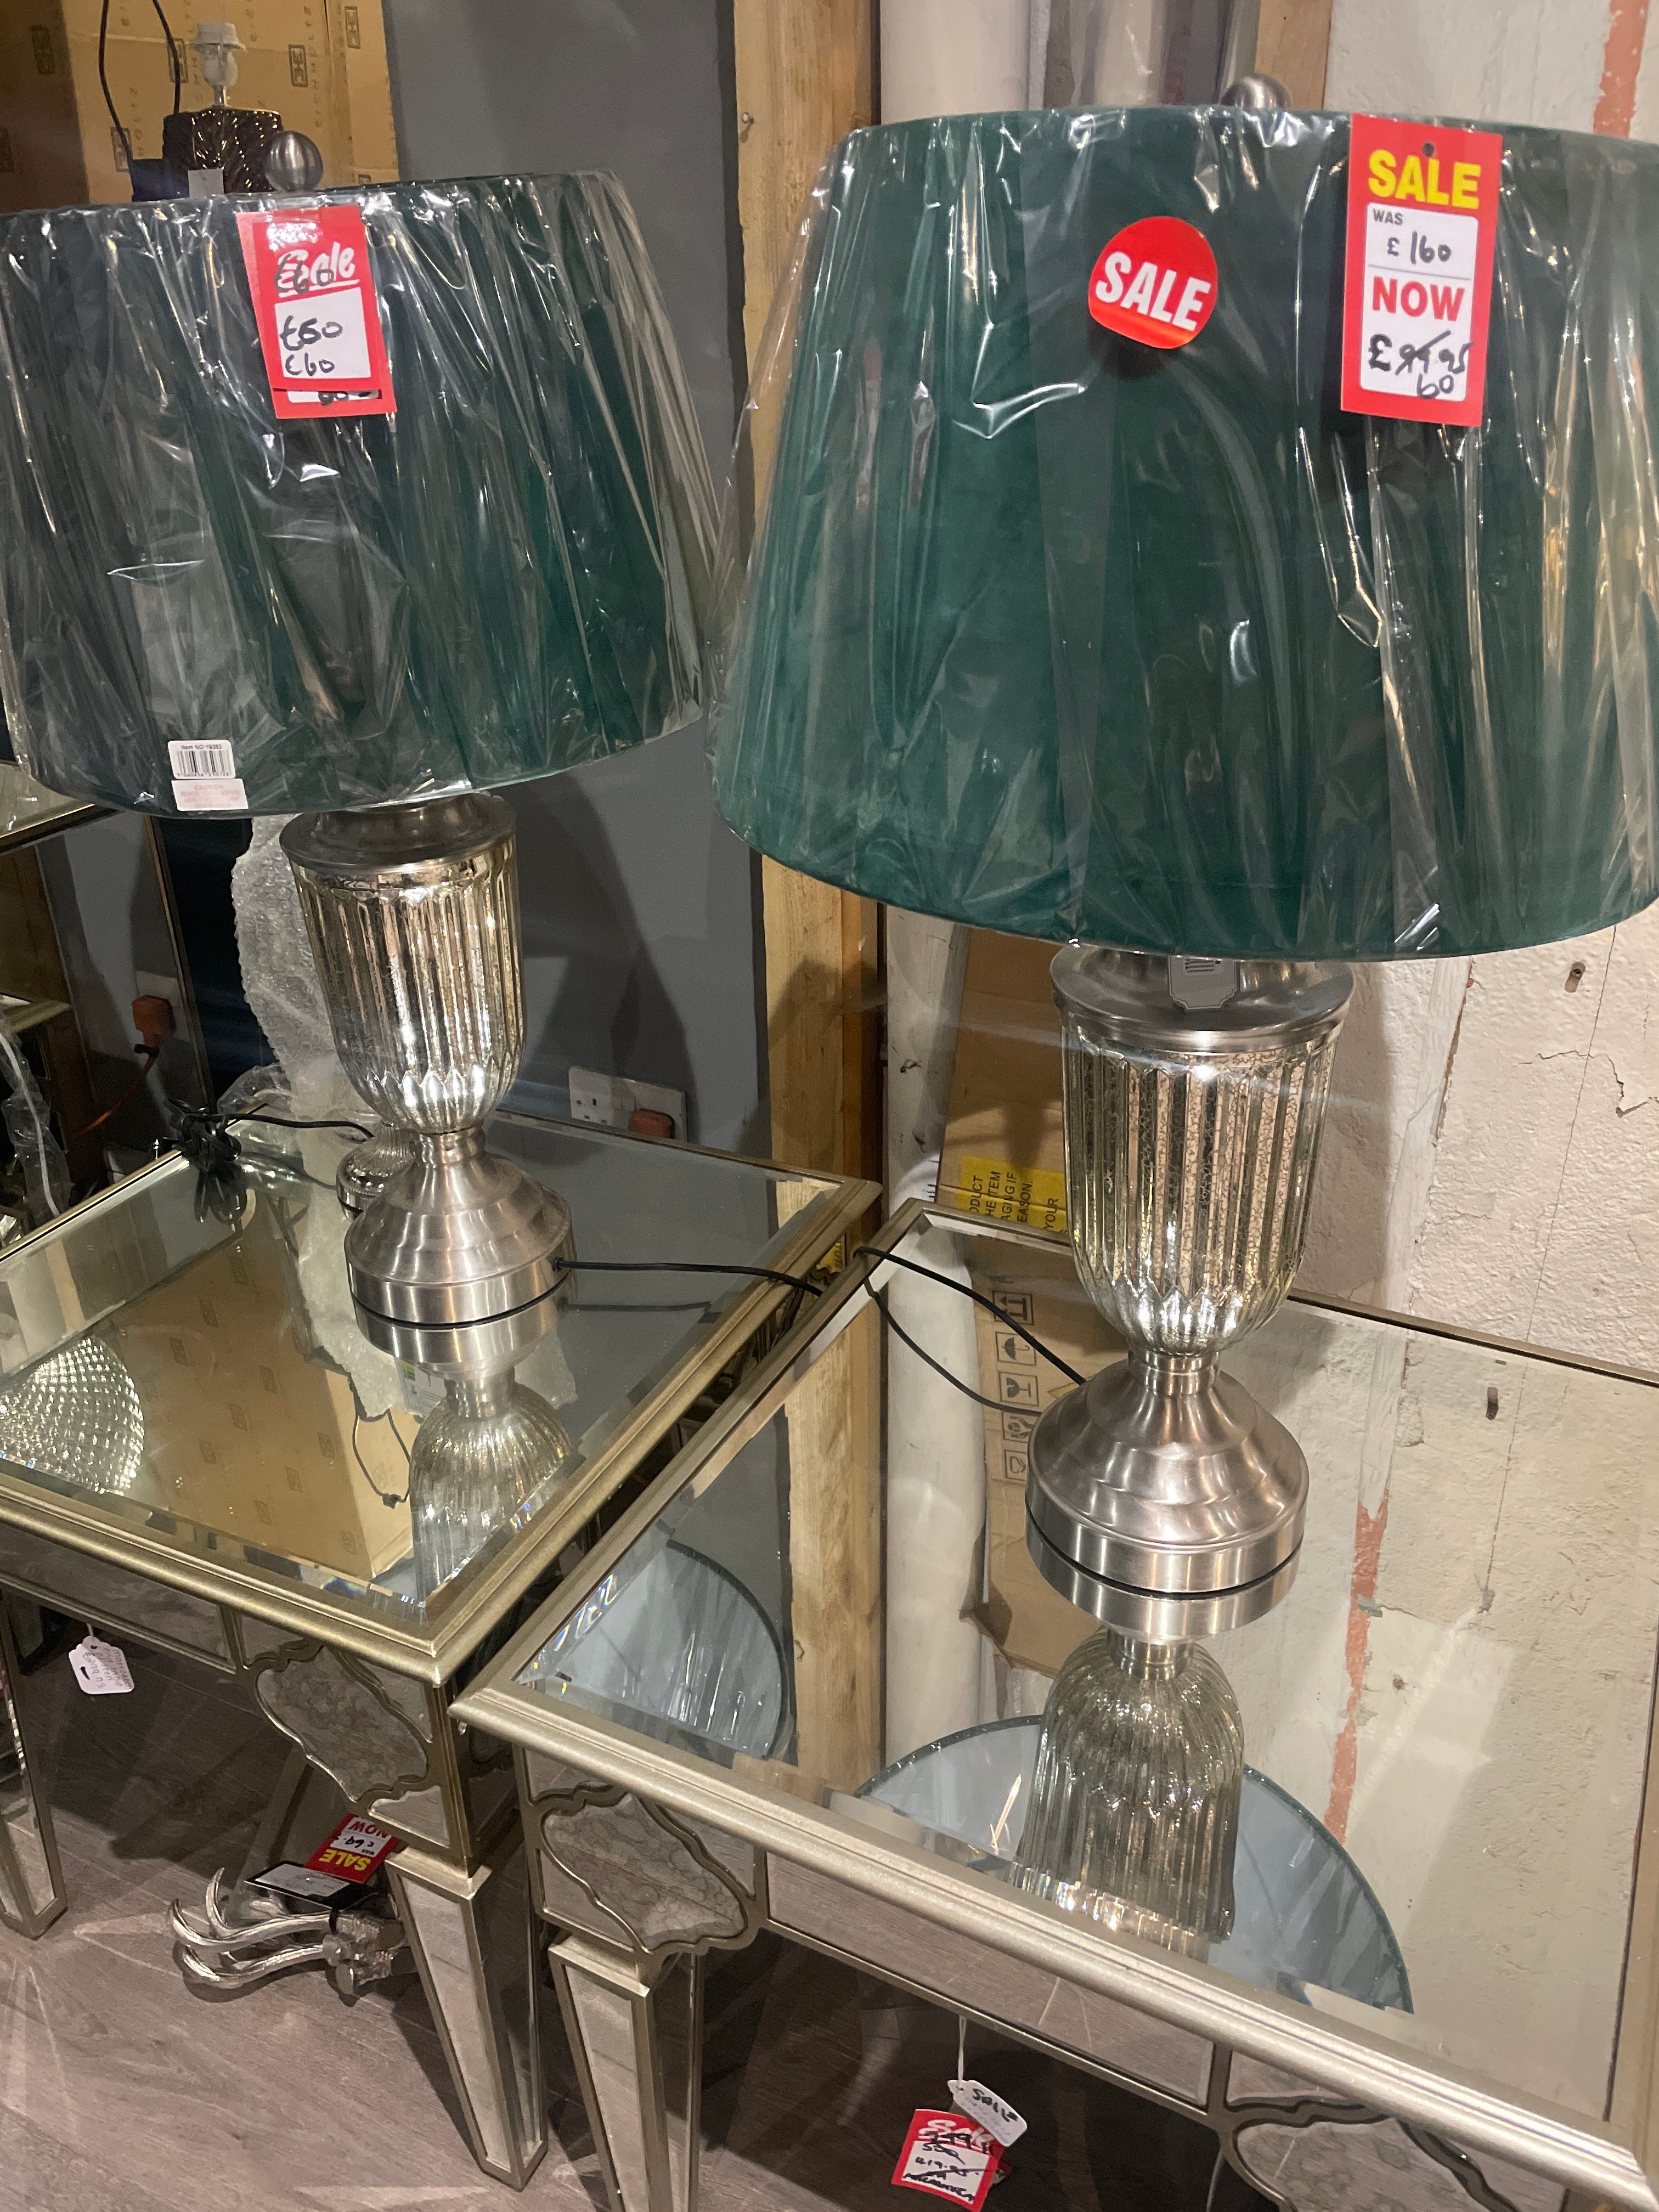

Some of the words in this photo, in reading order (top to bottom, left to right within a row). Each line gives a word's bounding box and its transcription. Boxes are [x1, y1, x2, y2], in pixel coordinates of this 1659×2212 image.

[1368, 149, 1482, 210] SALE
[1373, 208, 1404, 225] WAS
[1095, 251, 1211, 332] SALE
[1372, 275, 1465, 322] NOW
[1416, 372, 1454, 399] 60
[1007, 1171, 1017, 1184] IF
[1043, 1198, 1059, 1230] YOUR
[319, 1848, 371, 1871] SALE
